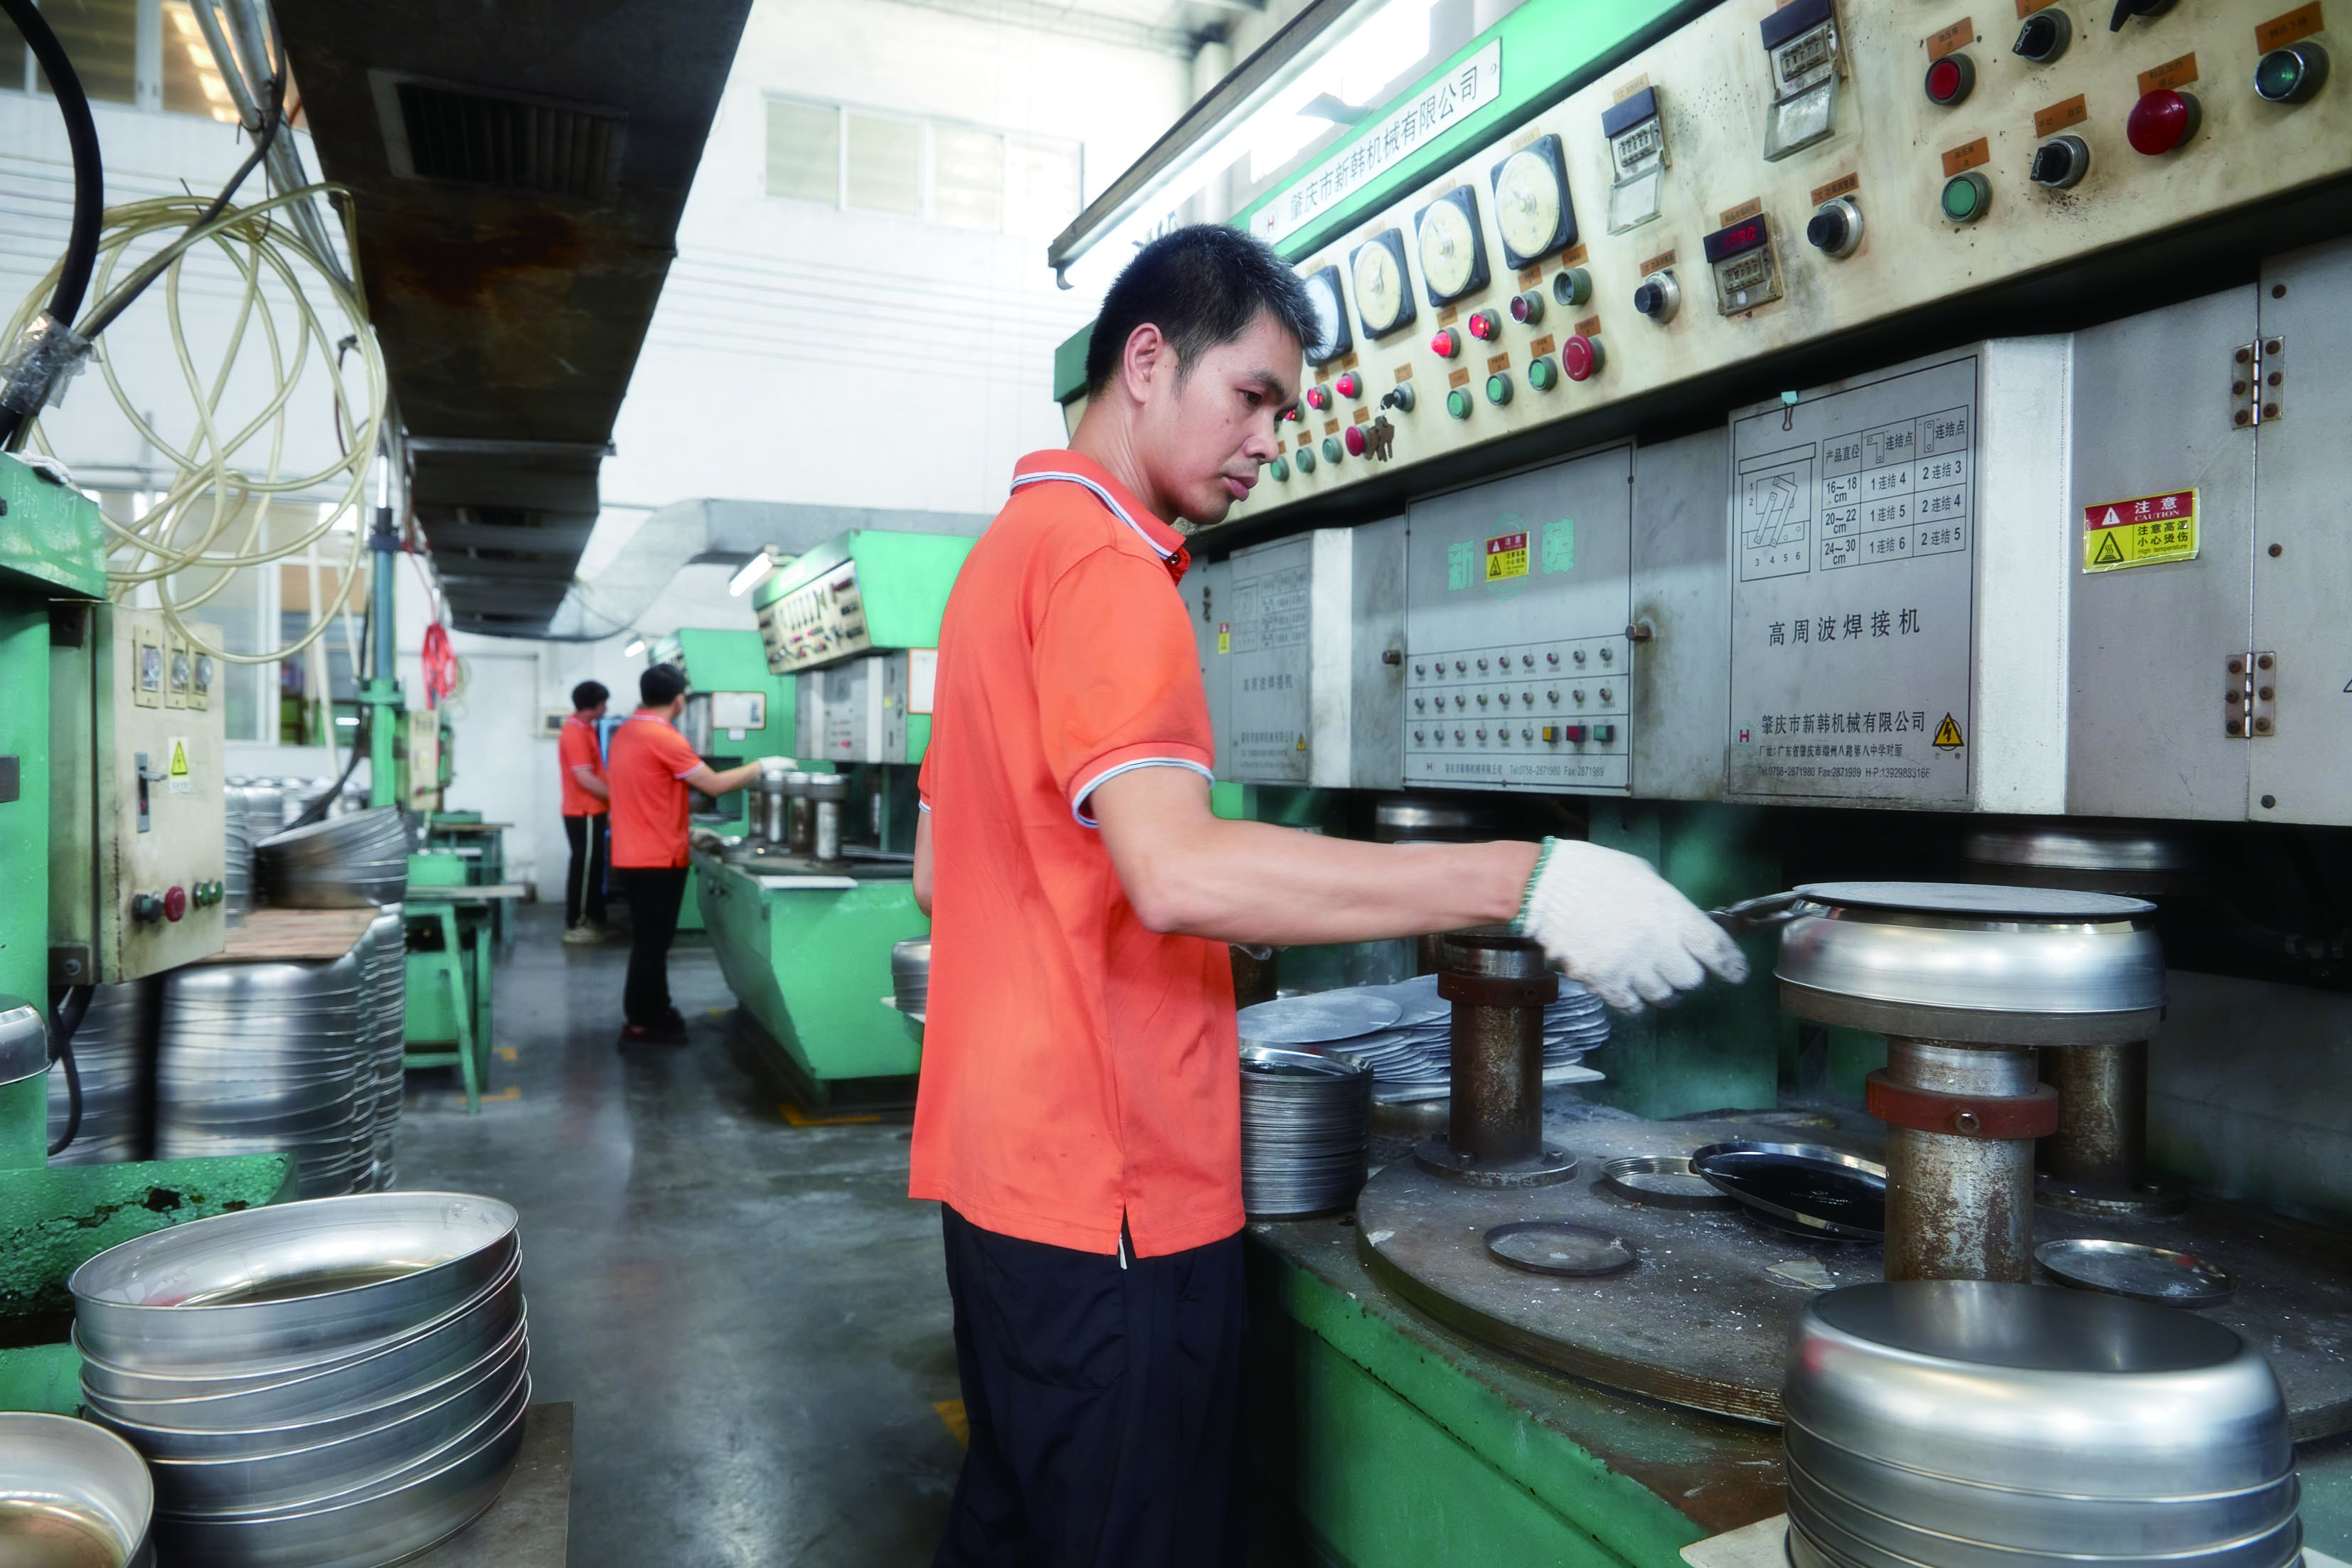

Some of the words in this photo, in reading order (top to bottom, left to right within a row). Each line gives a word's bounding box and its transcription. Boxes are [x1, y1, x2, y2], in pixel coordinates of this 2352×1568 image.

[1289, 65, 1477, 222] 肇庆市新韩机械有限公司
[1935, 419, 1966, 439] 连结点
[1885, 431, 1914, 451] 连结点
[1826, 444, 1861, 464] 产品直径
[1922, 466, 1930, 480] 2
[1932, 462, 1952, 479] 连结
[1955, 460, 1962, 474] 3
[1871, 478, 1875, 491] 1
[1878, 474, 1898, 490] 连结
[1900, 472, 1906, 484] 4
[1834, 492, 1847, 503] cm
[1922, 500, 1929, 513] 2
[1931, 496, 1951, 513] 连结
[1954, 494, 1962, 507] 4
[2134, 496, 2178, 514] 注意
[1870, 509, 1875, 522] 1
[1877, 506, 1896, 522] 连结
[1899, 504, 1906, 518] 5
[2134, 510, 2180, 522] CAUTION
[1834, 523, 1846, 534] cm
[1921, 533, 1928, 545] 2
[1930, 529, 1951, 546] 连结
[1954, 527, 1961, 540] 5
[2138, 520, 2188, 535] 注意高温
[1869, 541, 1874, 554] 1
[1876, 538, 1895, 555] 连结
[1899, 536, 1905, 550] 6
[2137, 532, 2188, 547] 小心烫伤
[1755, 558, 1760, 567] 3
[1770, 555, 1774, 564] 4
[1783, 553, 1788, 562] 5
[1796, 552, 1801, 561] 6
[1833, 554, 1846, 565] cm
[1769, 608, 1920, 646] 高周波焊接机
[1761, 710, 1925, 735] 肇庆市新韩机械有限公司
[1740, 729, 1750, 743] H
